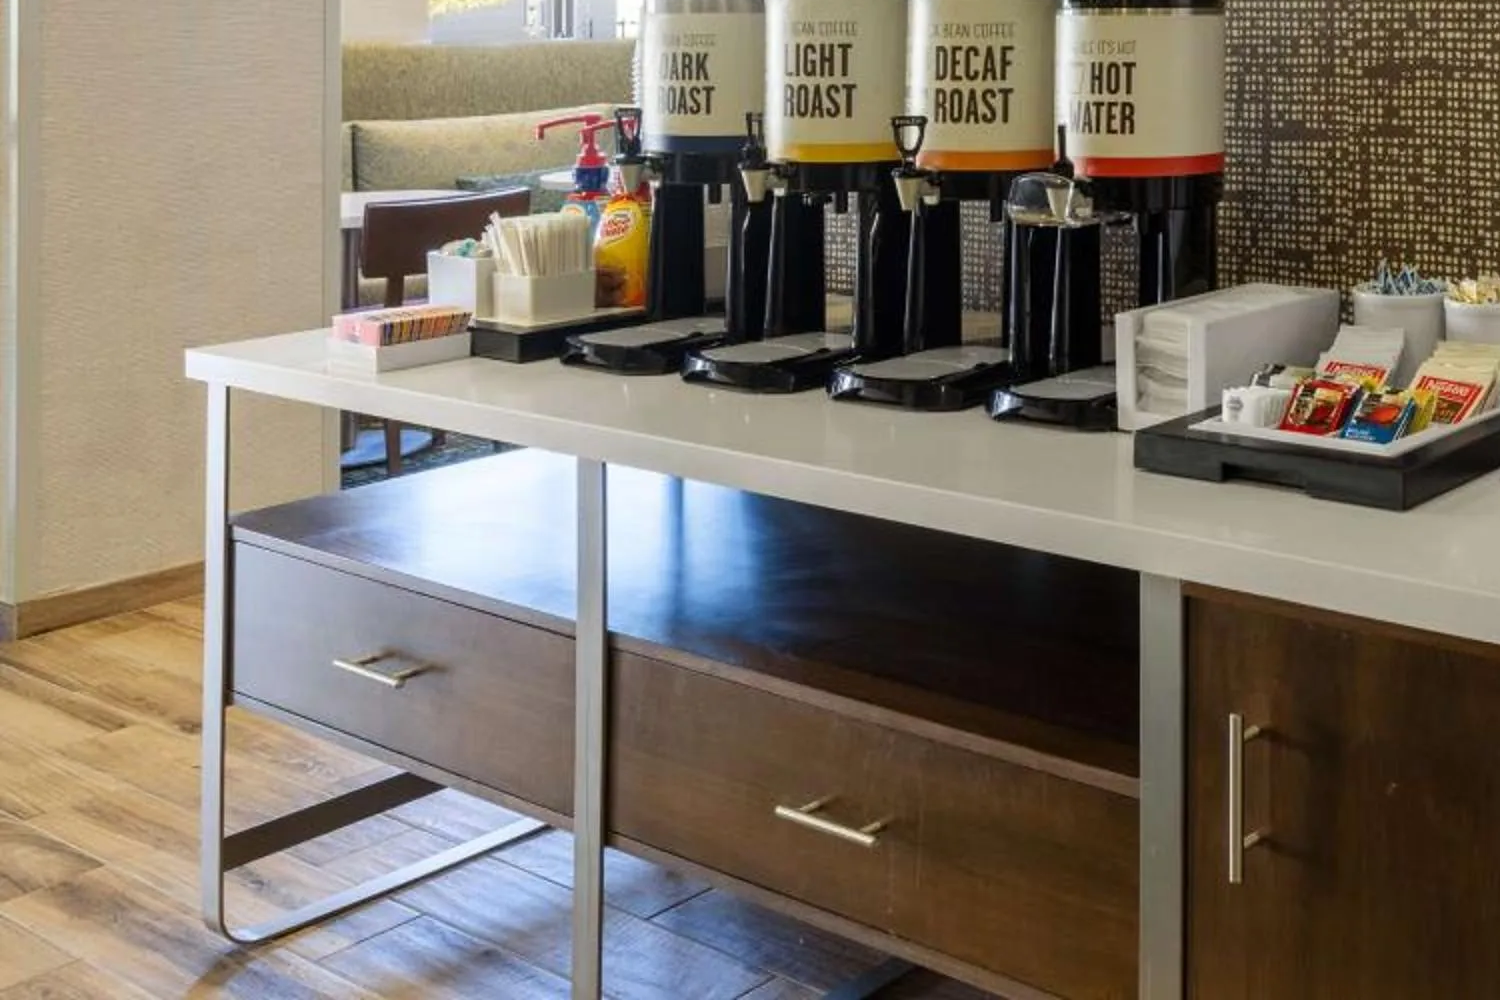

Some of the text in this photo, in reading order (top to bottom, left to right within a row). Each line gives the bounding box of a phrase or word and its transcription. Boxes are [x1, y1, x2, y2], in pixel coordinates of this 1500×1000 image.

[784, 43, 853, 77] LIGHT
[935, 45, 1015, 81] DECAF
[1090, 62, 1136, 95] HOT
[784, 83, 857, 118] ROAST
[934, 87, 1015, 124] ROAST
[1070, 101, 1135, 135] WATER
